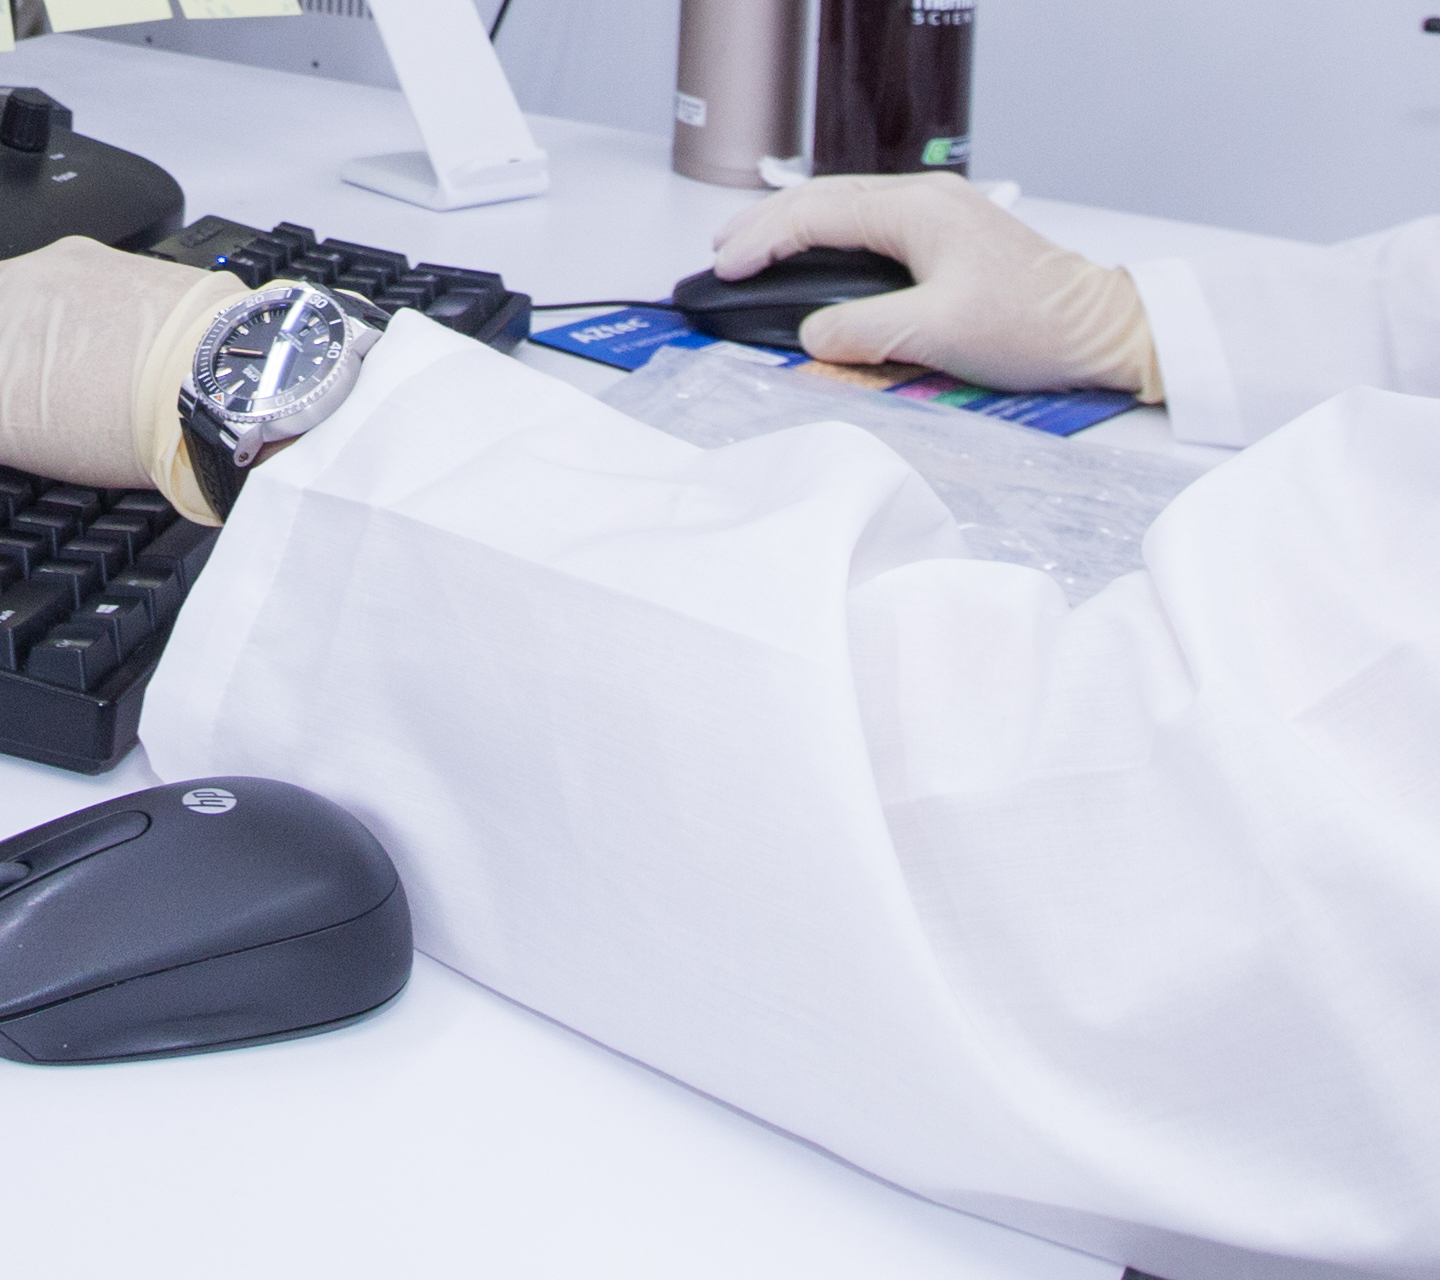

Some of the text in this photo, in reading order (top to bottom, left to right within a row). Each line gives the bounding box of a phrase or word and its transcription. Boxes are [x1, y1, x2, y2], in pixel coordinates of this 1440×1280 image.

[245, 294, 265, 308] 20
[309, 294, 328, 309] 30
[326, 341, 342, 359] 40
